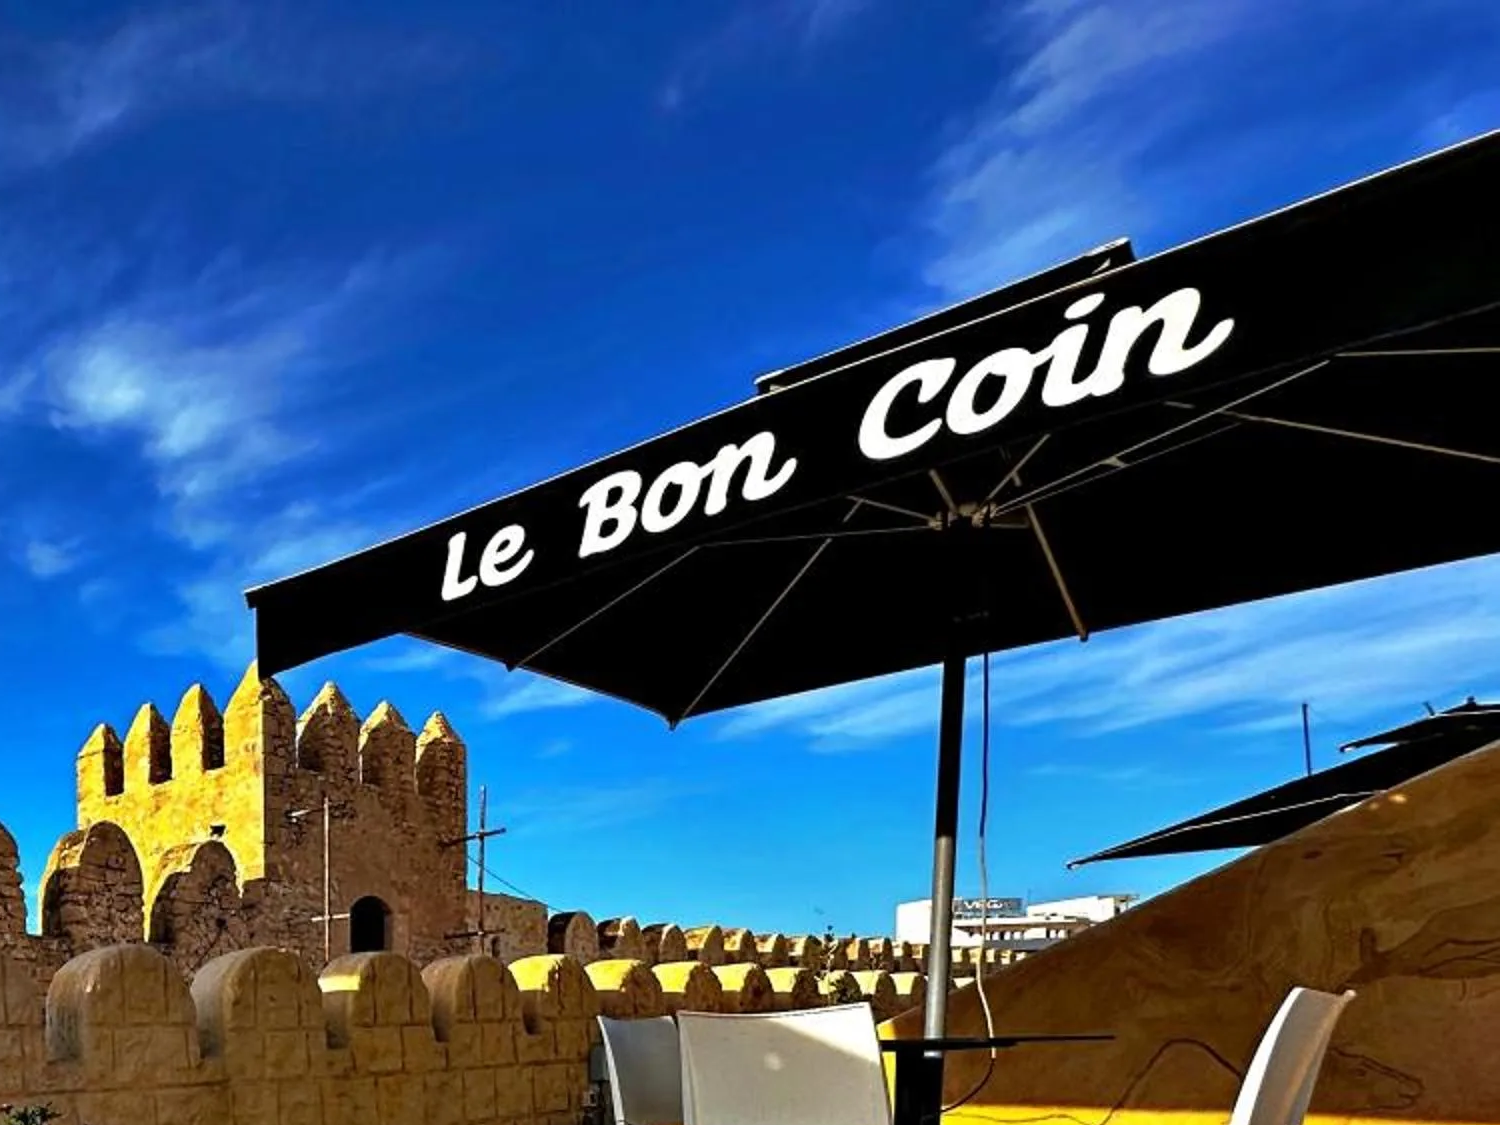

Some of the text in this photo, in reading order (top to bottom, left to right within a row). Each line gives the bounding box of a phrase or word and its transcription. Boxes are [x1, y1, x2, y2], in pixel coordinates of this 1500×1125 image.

[440, 286, 1235, 601] Le Bon Coin
